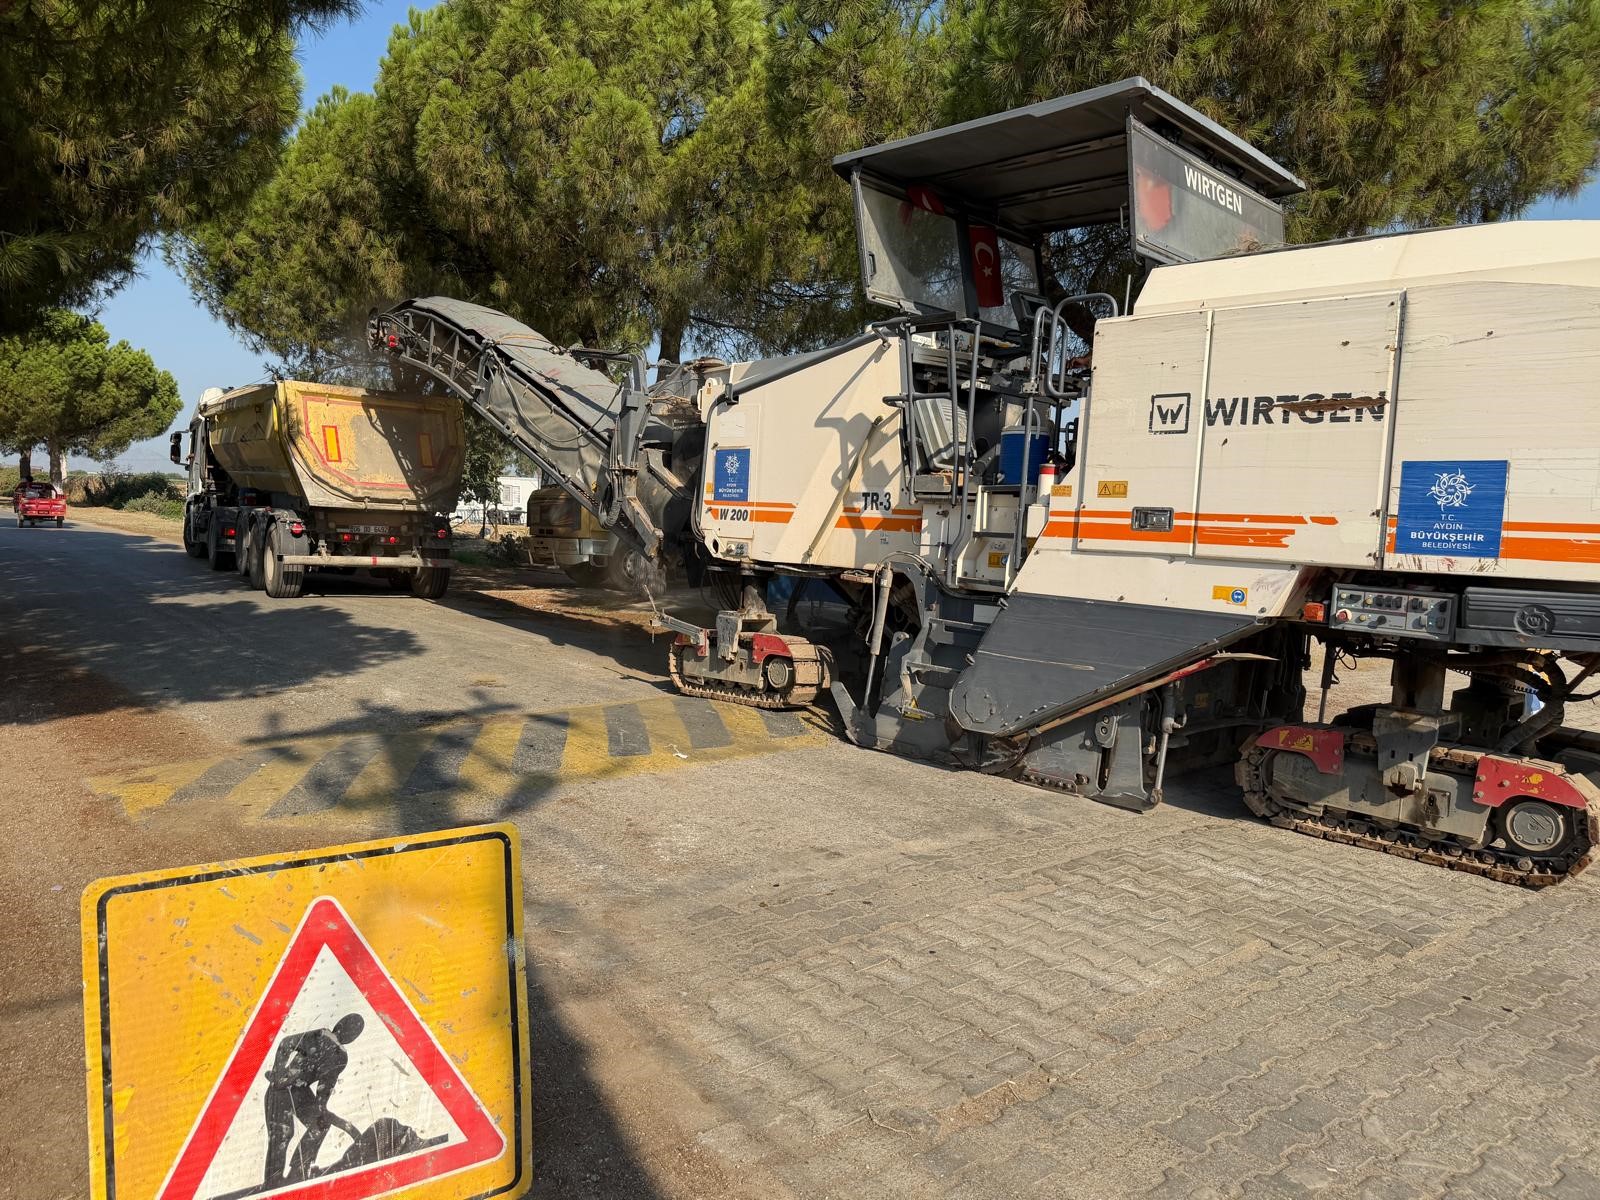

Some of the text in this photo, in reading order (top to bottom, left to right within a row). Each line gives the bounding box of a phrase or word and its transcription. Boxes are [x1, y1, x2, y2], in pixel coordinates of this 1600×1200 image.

[1184, 165, 1242, 215] WIRTGEN
[862, 492, 891, 511] TR-3
[720, 508, 748, 521] W 200
[1410, 531, 1485, 542] BÜYÜKŞEHİR
